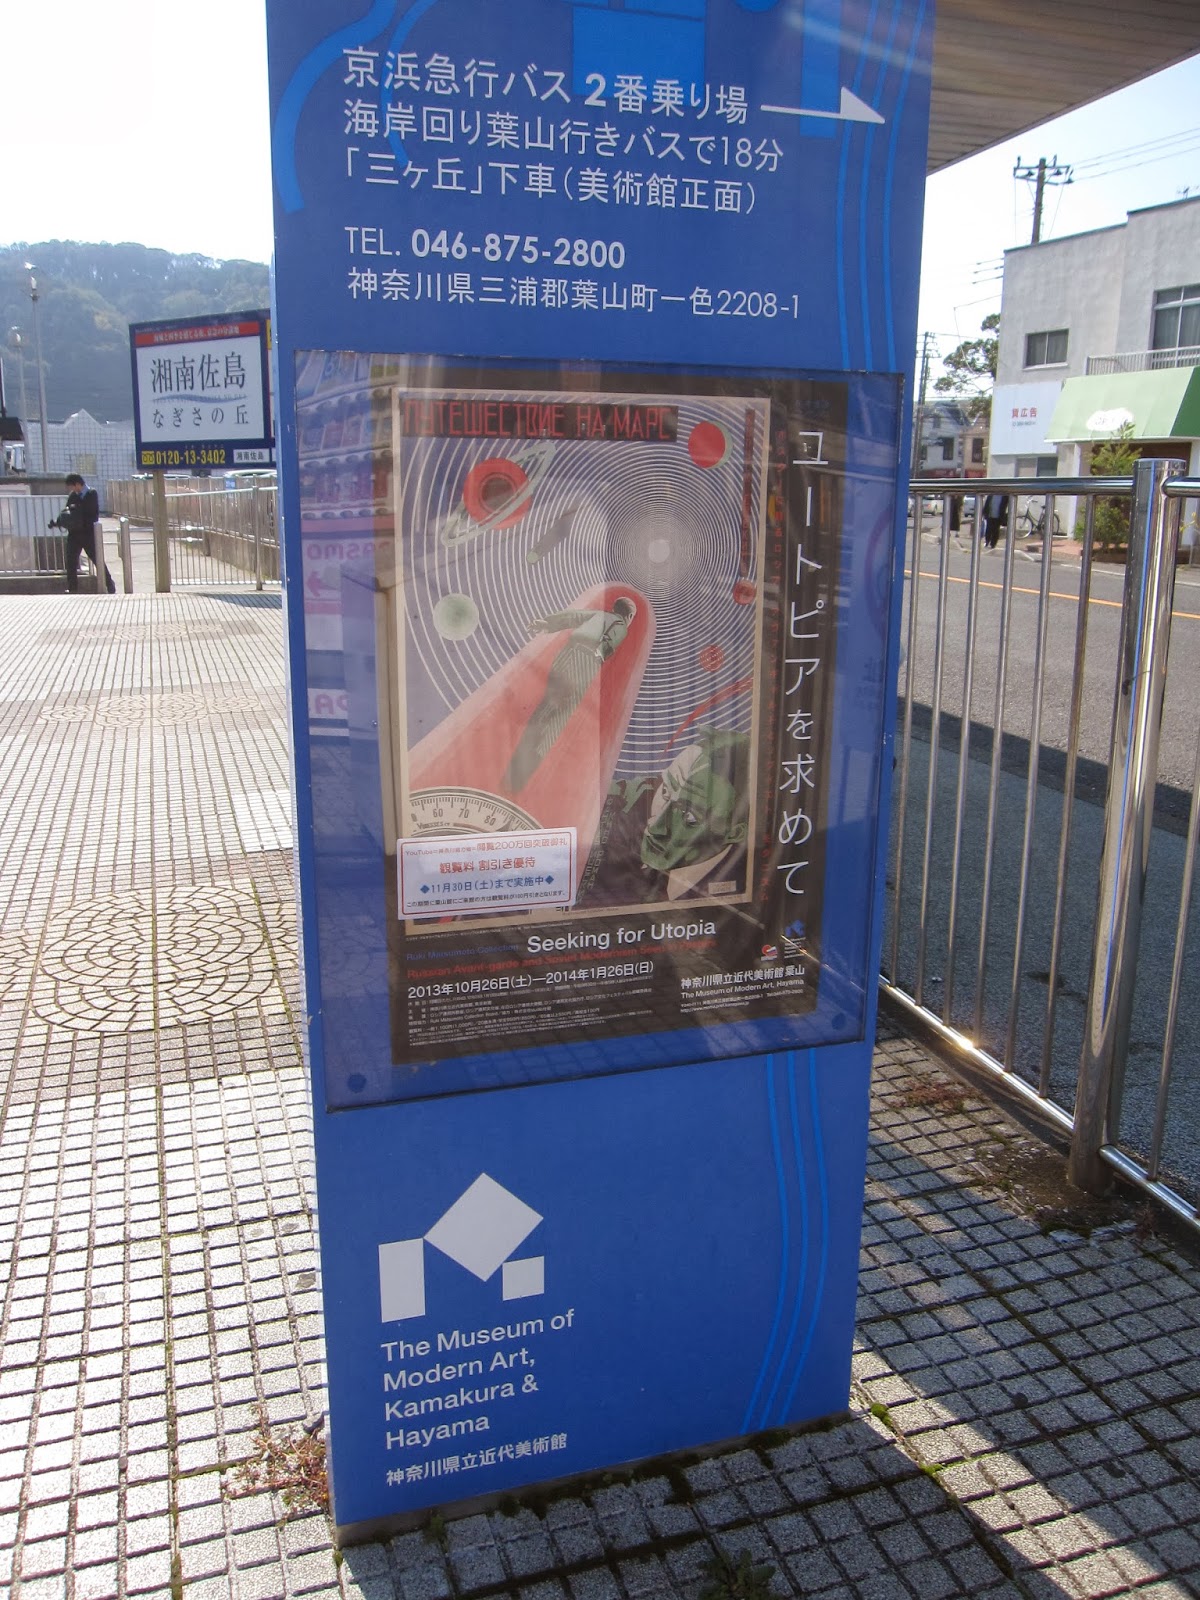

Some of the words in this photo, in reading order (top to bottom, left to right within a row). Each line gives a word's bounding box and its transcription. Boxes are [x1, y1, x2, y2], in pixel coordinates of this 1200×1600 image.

[343, 99, 785, 172] 海岸回り葉山行きバスで18分
[344, 226, 401, 257] TEL.
[411, 229, 625, 269] 046-875-2800
[347, 266, 799, 319] 神奈川県三浦郡葉山町一色2208-1
[150, 351, 246, 394] 湘南佐島
[152, 404, 249, 429] なぎさの丘
[155, 449, 226, 465] 0120-13-3402
[775, 431, 829, 897] ユートピアを求めて
[432, 808, 444, 818] 60
[458, 808, 470, 819] 70
[484, 815, 497, 827] 80
[439, 860, 475, 874] 観覧料
[478, 856, 536, 872] 割引き優待
[526, 931, 610, 954] Seeking
[616, 927, 646, 944] for
[650, 919, 717, 941] Utopia
[681, 991, 695, 999] The
[695, 988, 725, 998] Museum
[726, 986, 734, 994] of
[734, 983, 762, 992] Modern
[776, 978, 805, 988] Hayama
[381, 1340, 431, 1362] The
[437, 1317, 544, 1352] Museum
[550, 1308, 575, 1330] of
[383, 1359, 483, 1392] Modern
[490, 1348, 536, 1372] Art,
[385, 1383, 515, 1421] Kamakura
[521, 1374, 539, 1394] &
[386, 1415, 490, 1450] Hayama
[386, 1432, 568, 1487] 神奈川県立近代美術館
